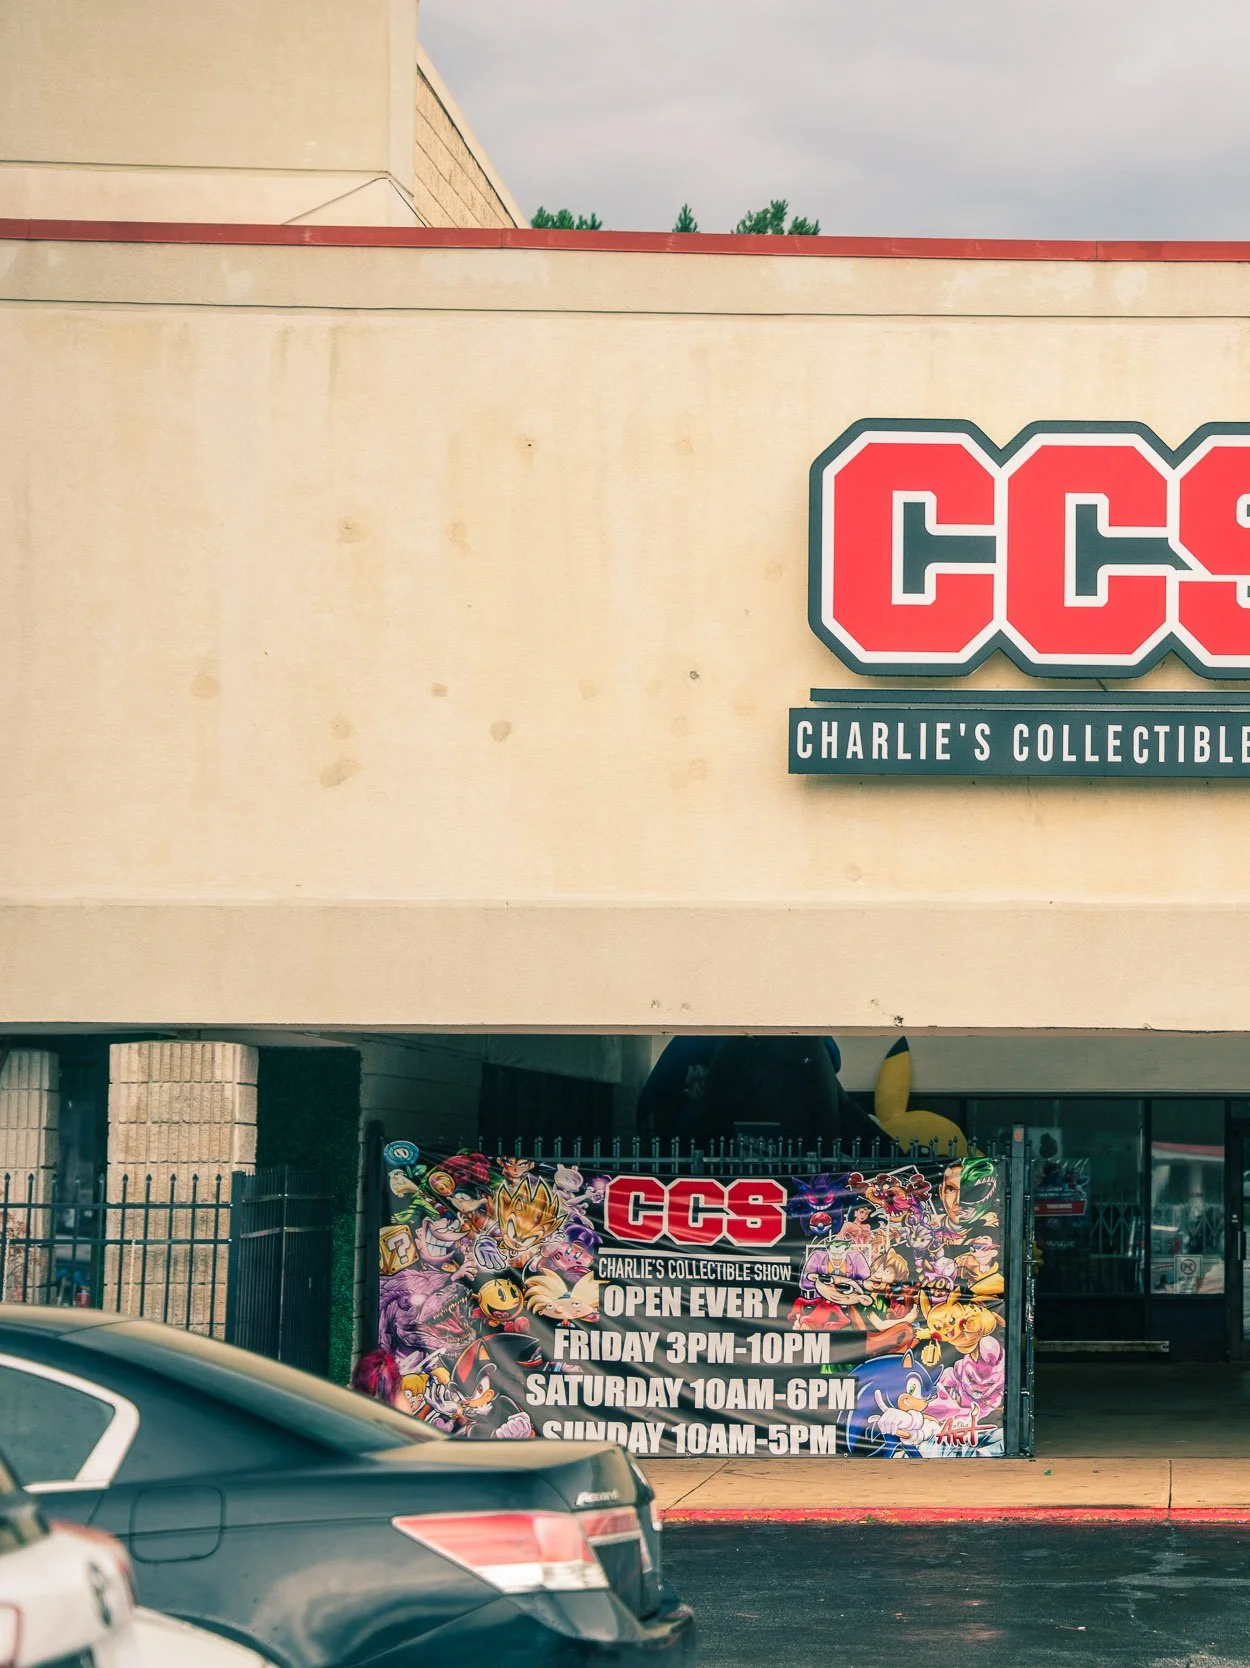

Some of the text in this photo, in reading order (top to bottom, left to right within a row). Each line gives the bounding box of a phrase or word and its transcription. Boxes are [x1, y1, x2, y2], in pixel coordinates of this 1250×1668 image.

[795, 720, 991, 761] CHARLIE'S
[604, 1175, 788, 1248] CCS
[598, 1257, 792, 1281] CHARLIE'S COLLECTIBLE SHOW
[603, 1284, 783, 1318] OPEN EVERY
[553, 1329, 831, 1364] FRIDAY 3PM-10PM
[525, 1373, 856, 1411] SATURDAY 10AM-6PM
[671, 1423, 837, 1456] 10AM-5PM
